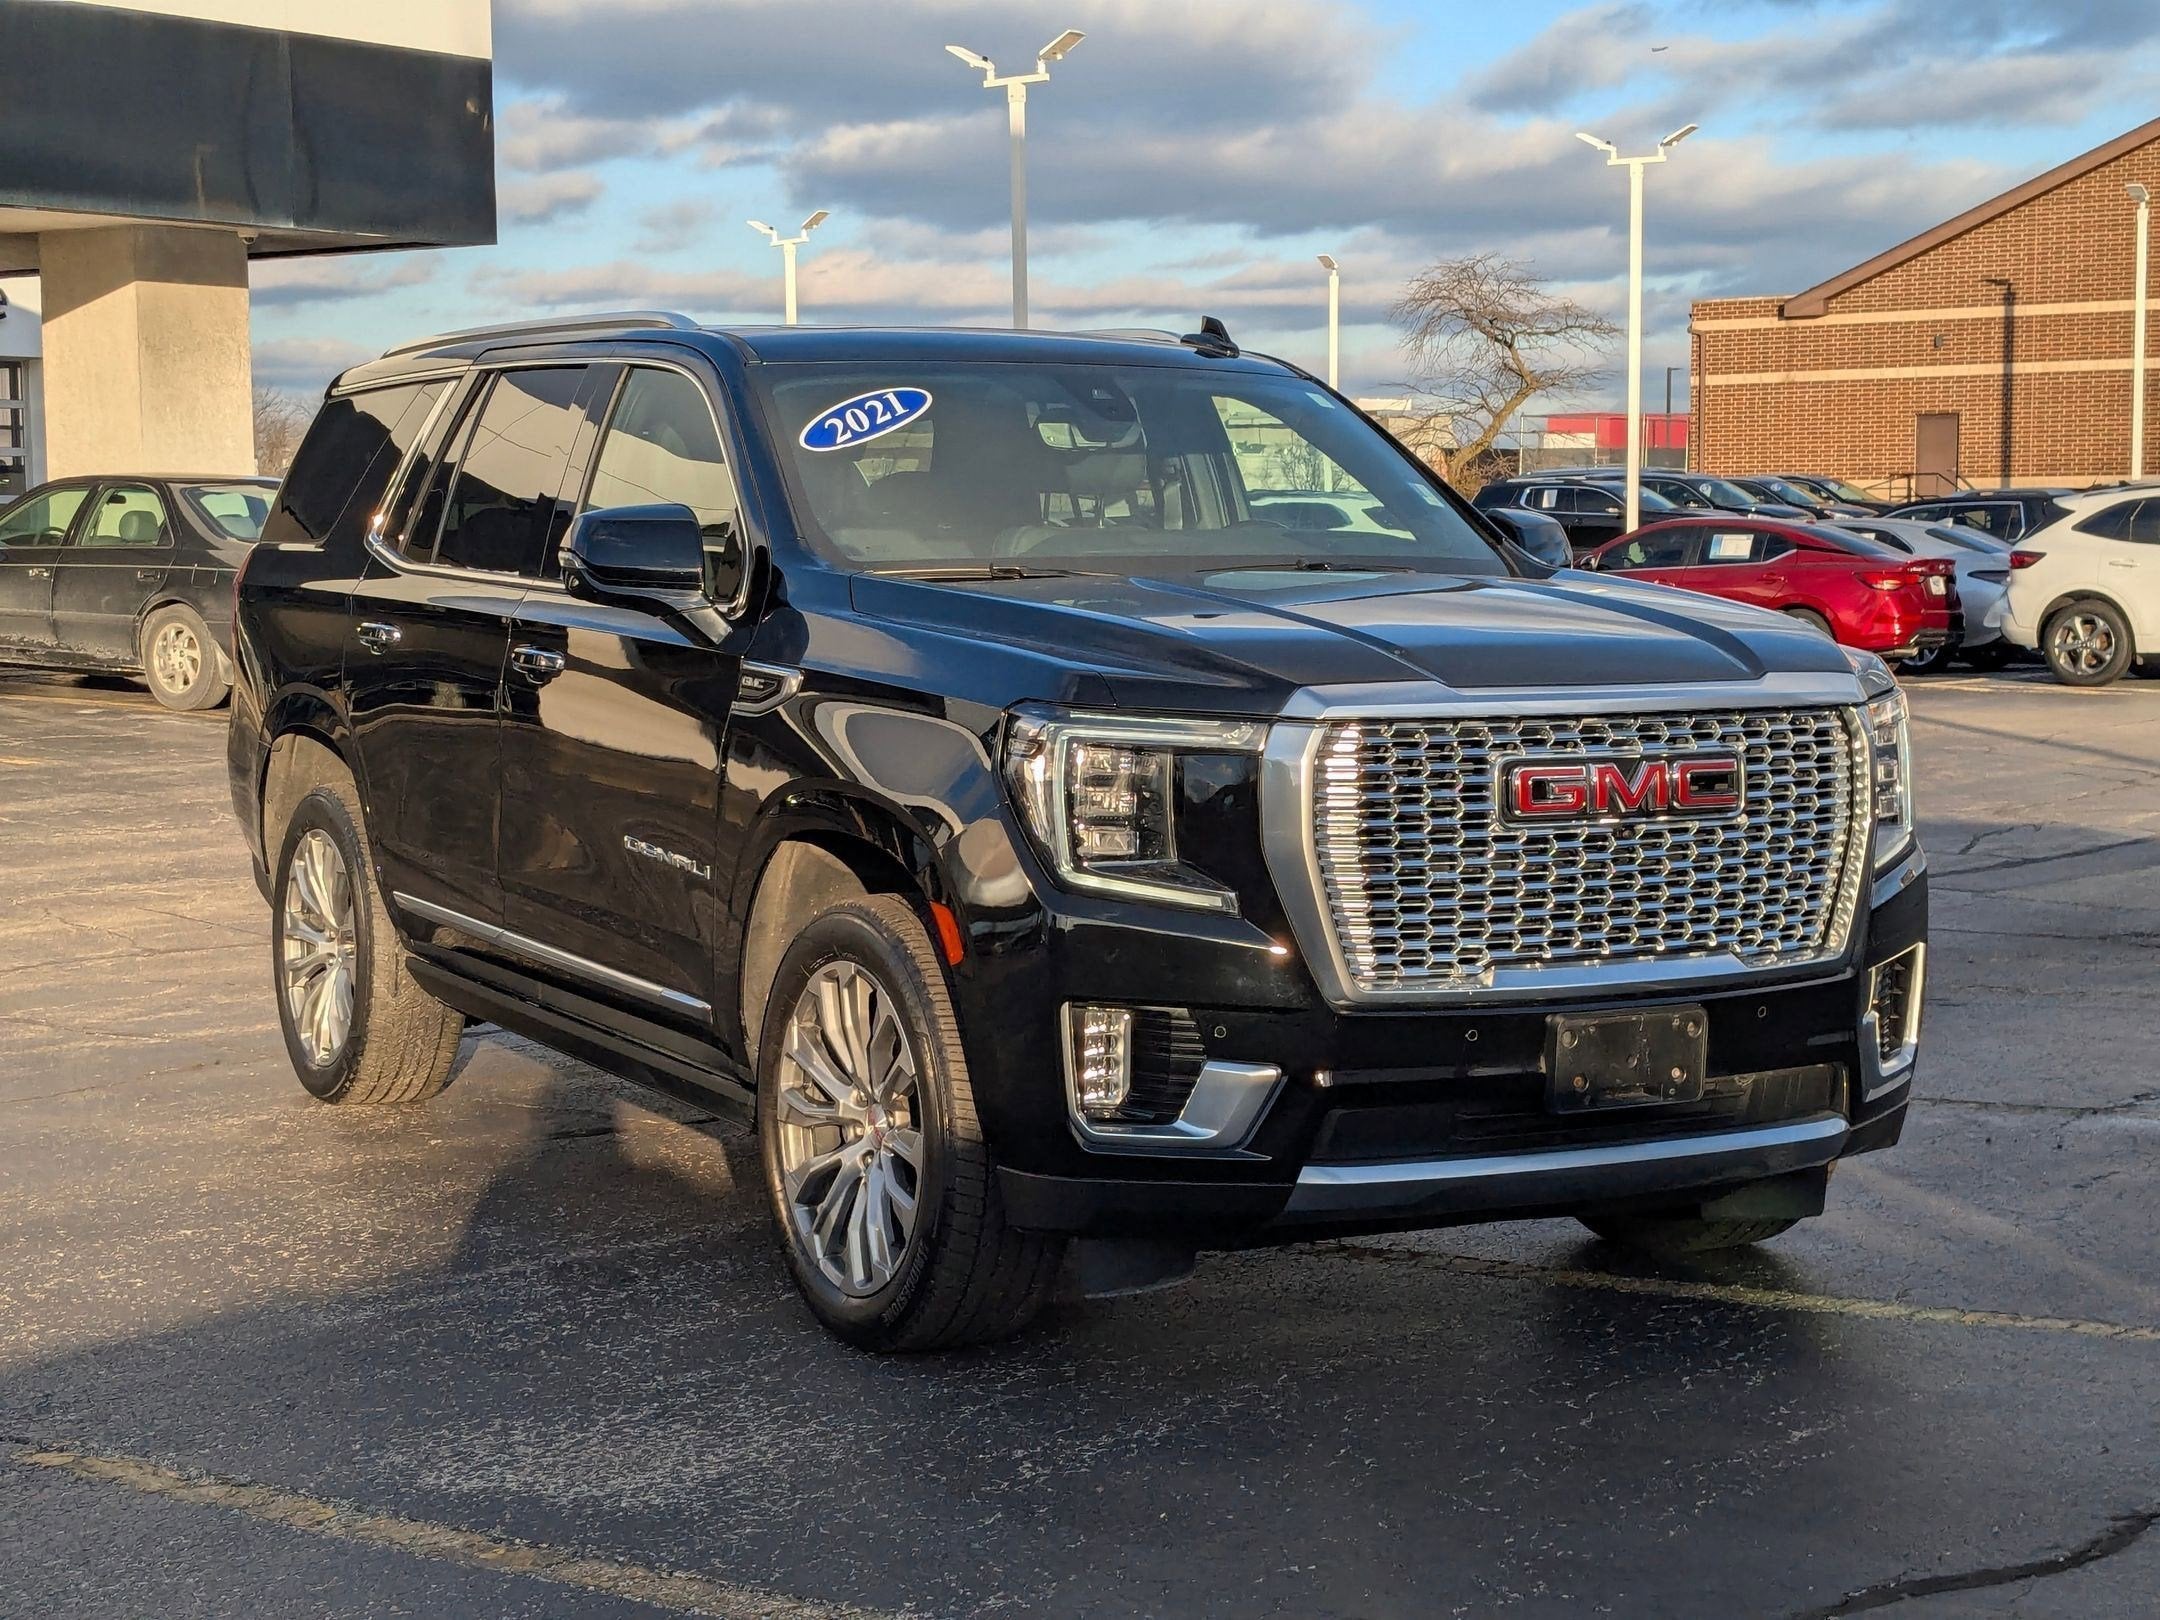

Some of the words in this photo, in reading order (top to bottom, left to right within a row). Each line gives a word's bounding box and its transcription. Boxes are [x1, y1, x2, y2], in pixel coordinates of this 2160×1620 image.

[824, 392, 909, 444] 2021
[1514, 760, 1738, 814] GMC
[624, 835, 711, 880] DENALI
